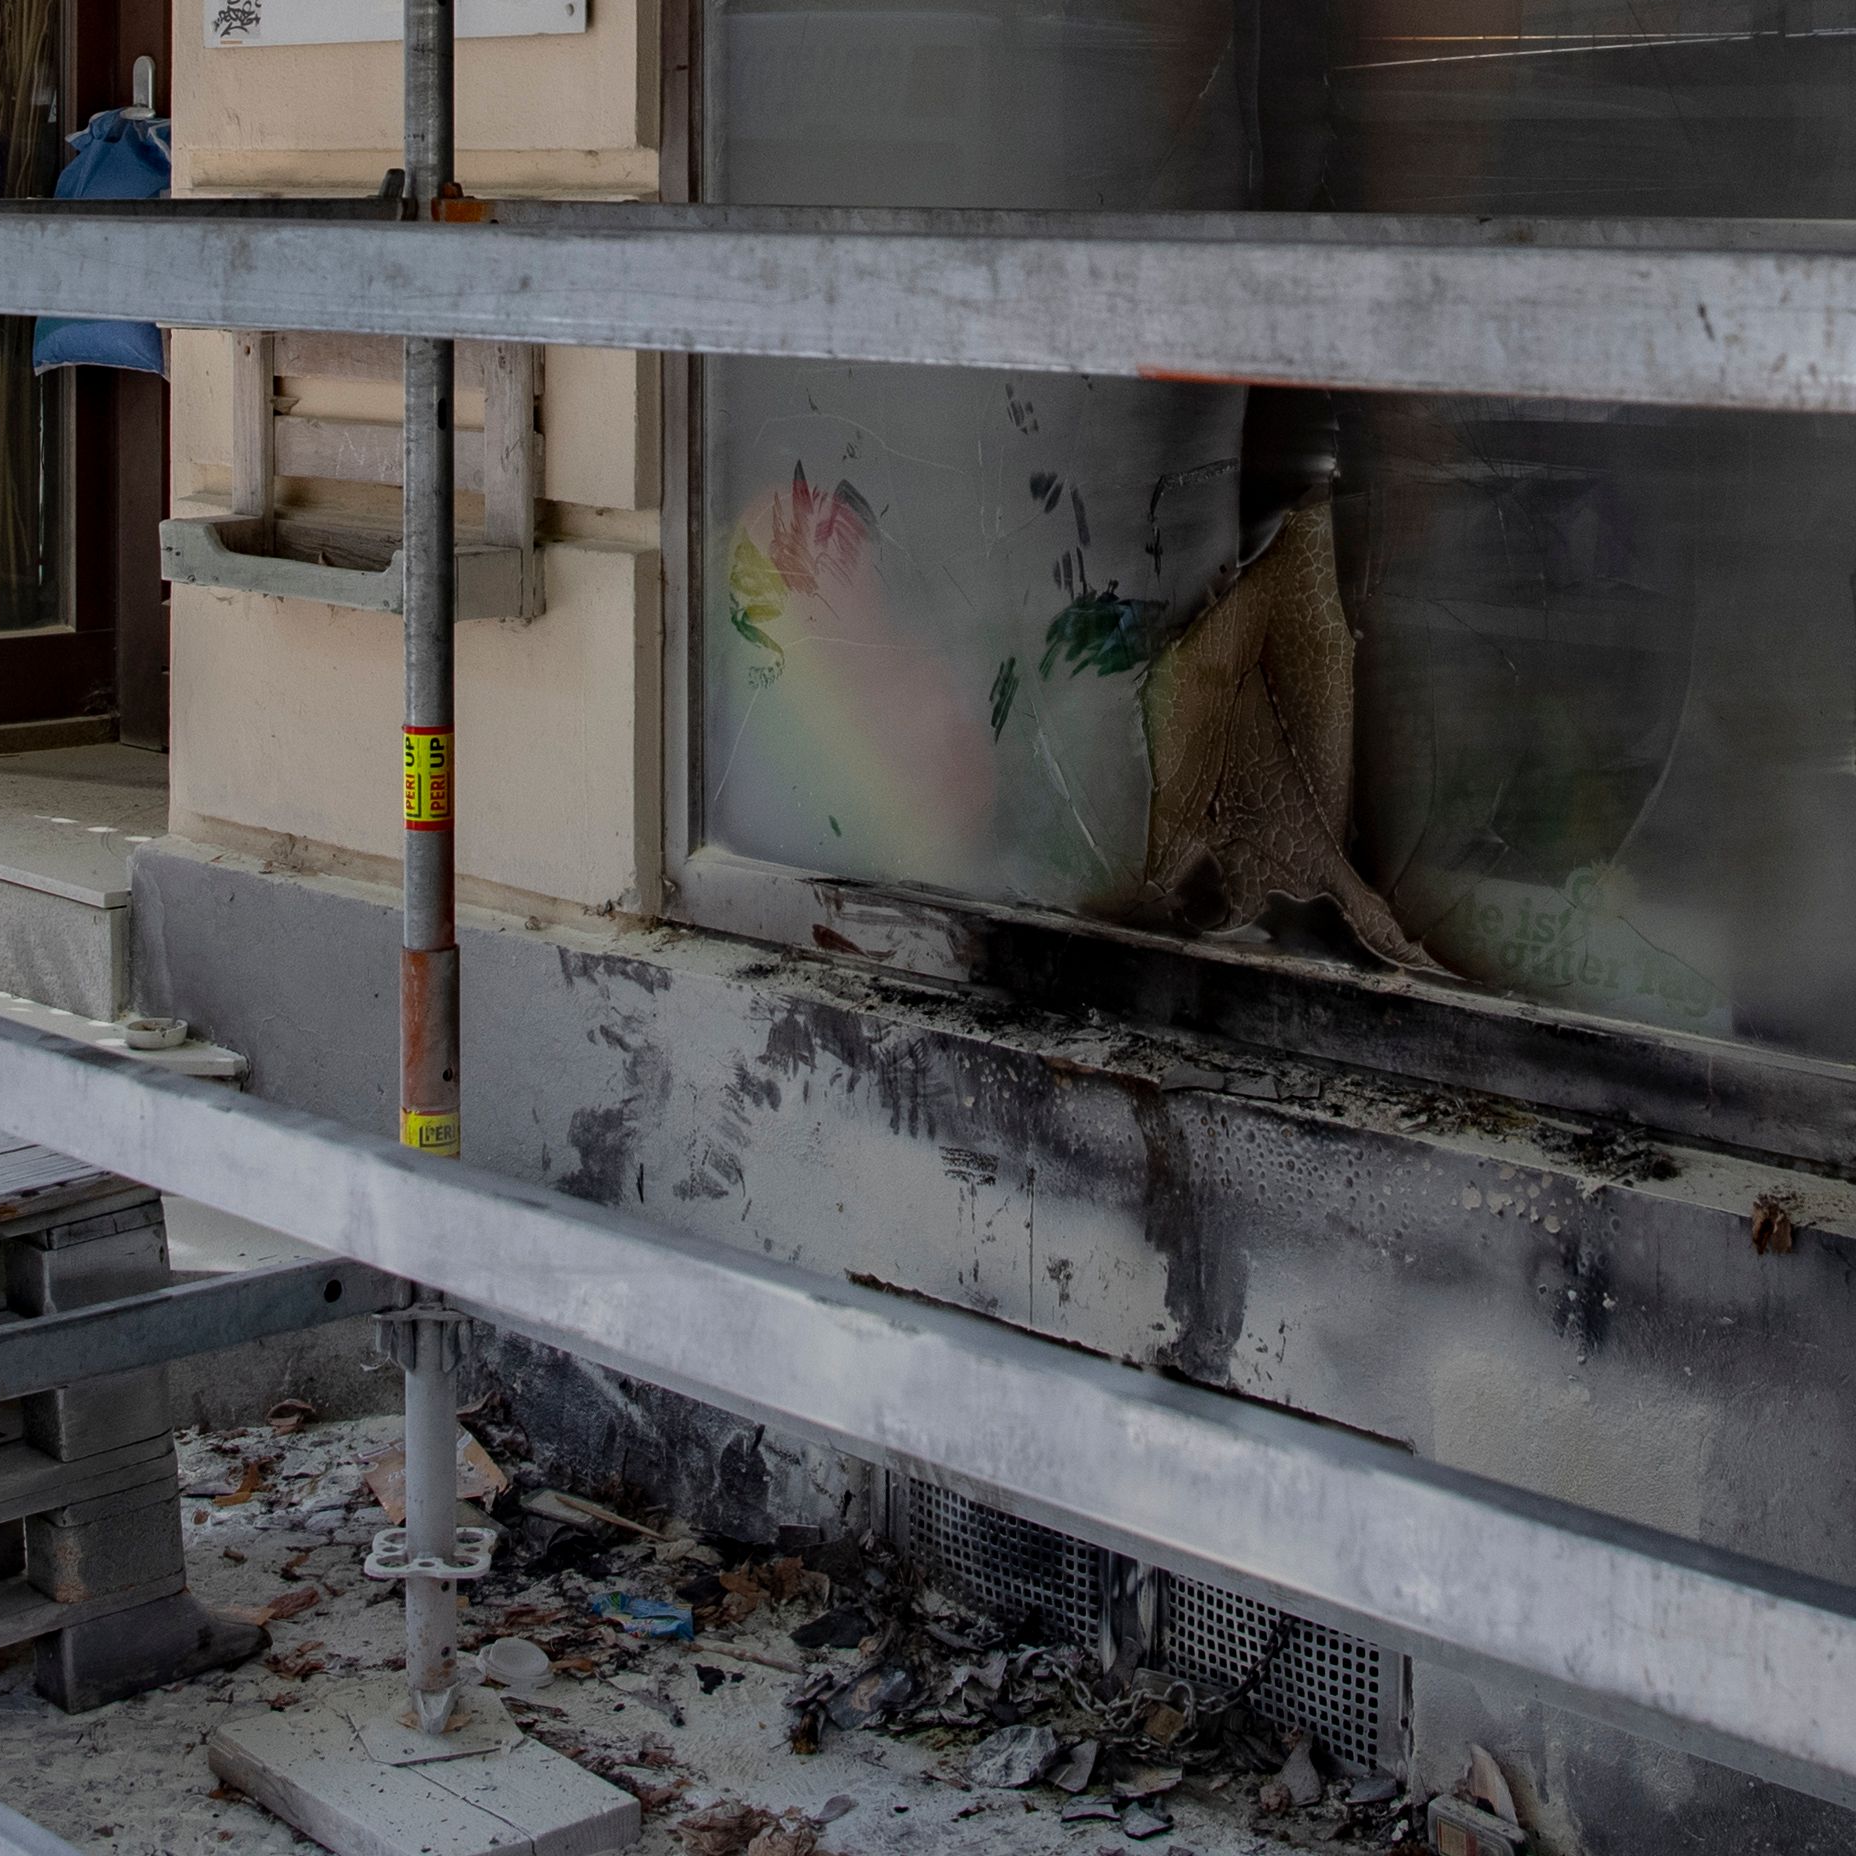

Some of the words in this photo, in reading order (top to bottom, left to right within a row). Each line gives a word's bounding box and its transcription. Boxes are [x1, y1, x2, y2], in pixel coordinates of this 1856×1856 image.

[405, 736, 415, 767] UP
[430, 737, 445, 768] UP
[405, 774, 415, 811] PERI
[430, 774, 446, 811] PERI
